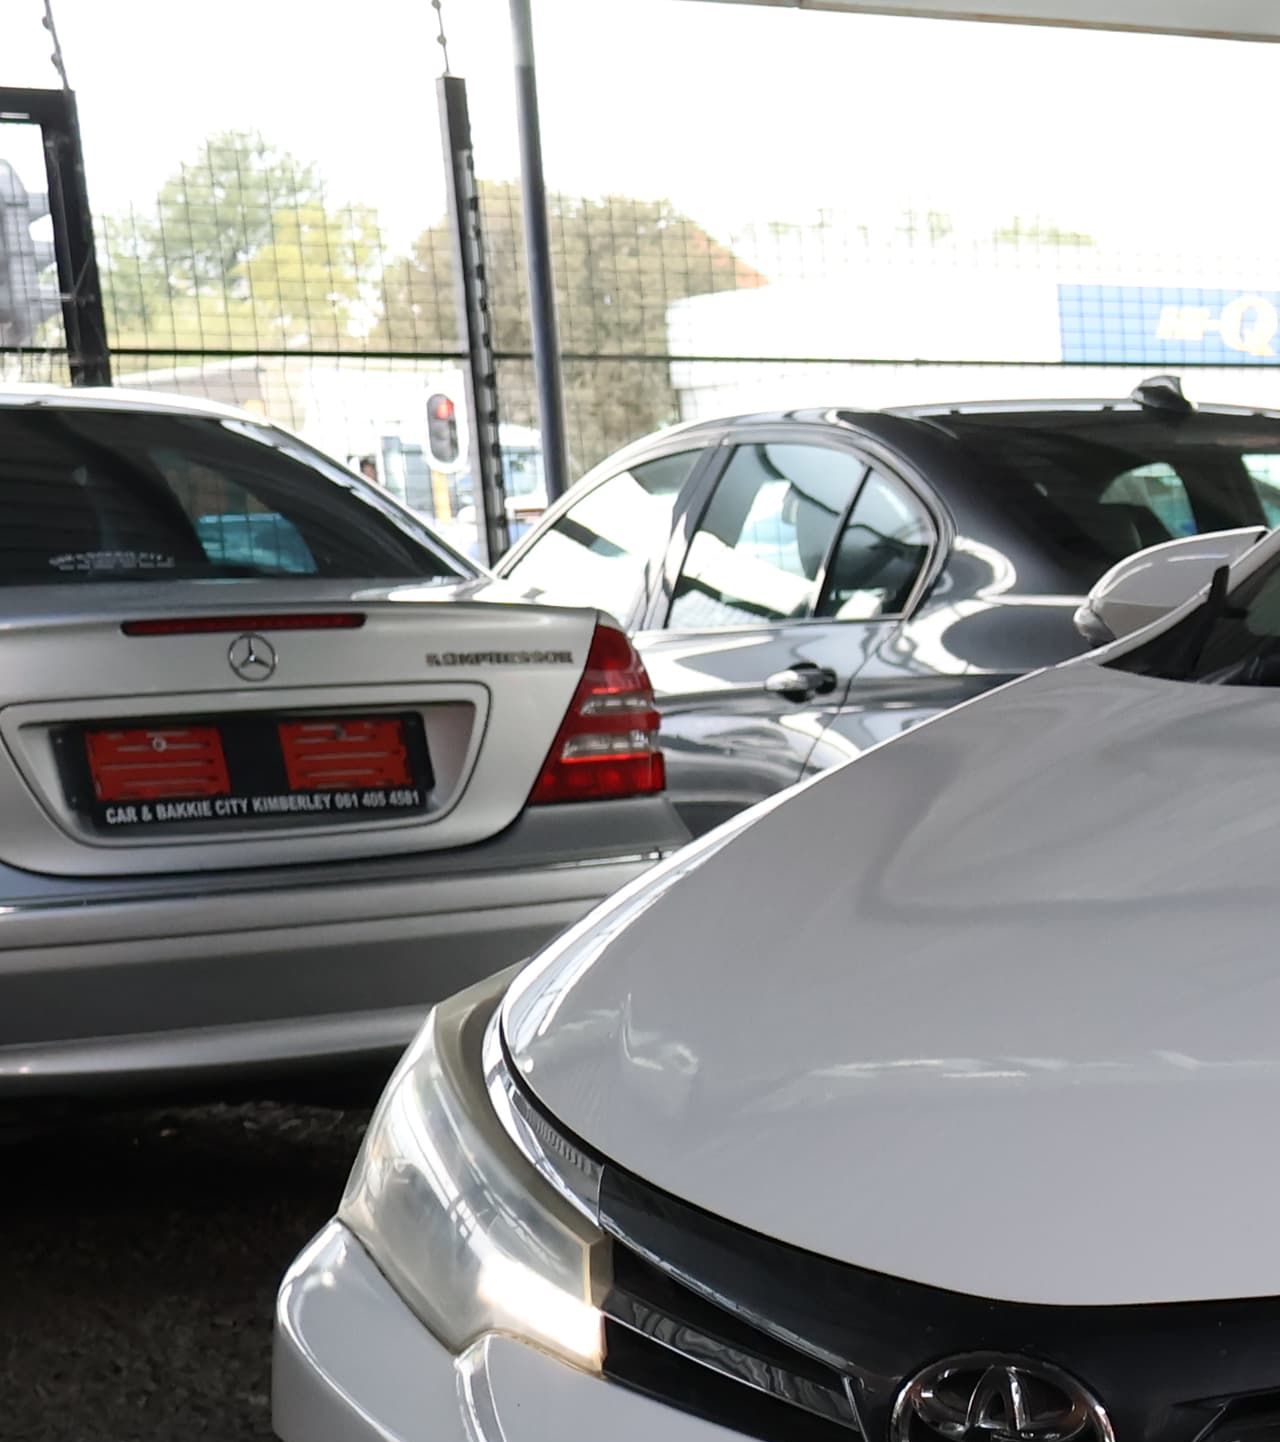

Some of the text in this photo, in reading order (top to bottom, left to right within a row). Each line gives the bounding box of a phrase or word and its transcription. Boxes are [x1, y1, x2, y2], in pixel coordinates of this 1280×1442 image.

[426, 650, 574, 667] KOMPRESSOR
[106, 789, 420, 824] CAR & BAKKIE CITY KIMBERLEY 061 405 4581
